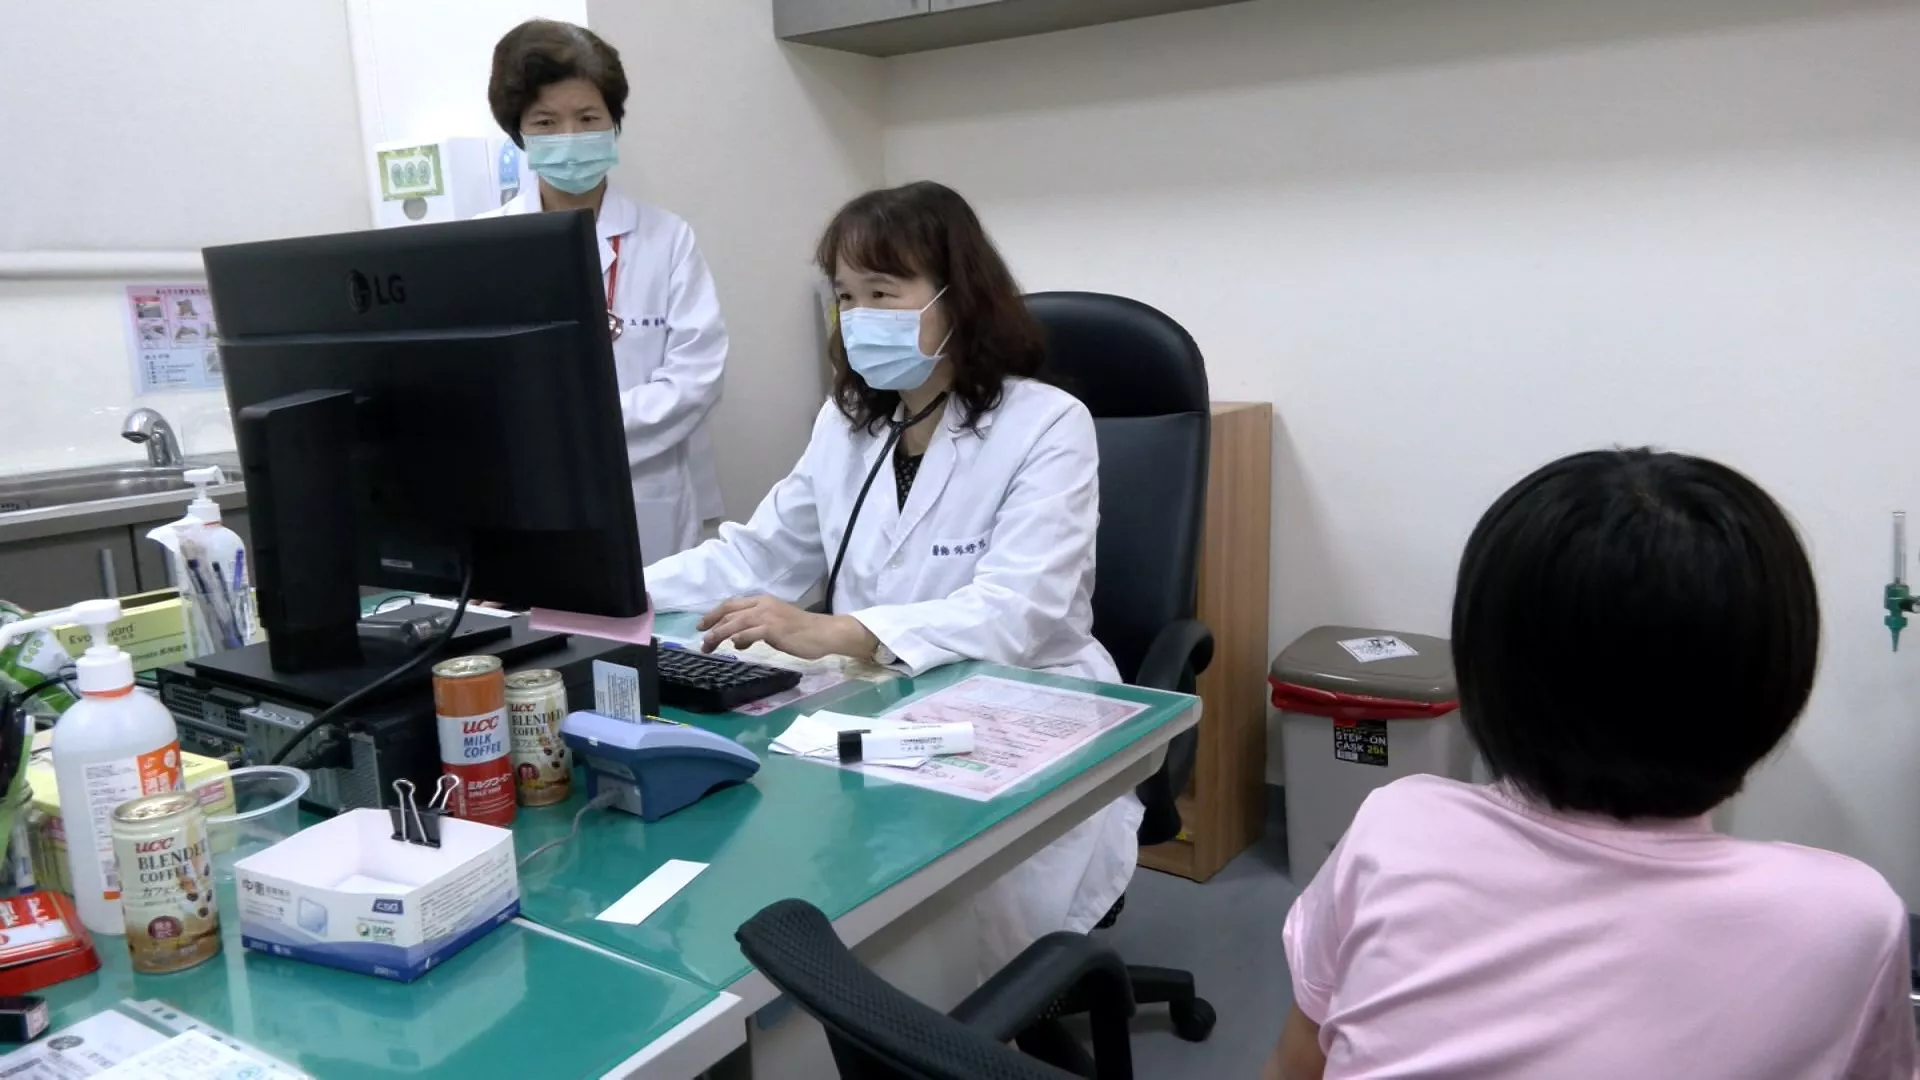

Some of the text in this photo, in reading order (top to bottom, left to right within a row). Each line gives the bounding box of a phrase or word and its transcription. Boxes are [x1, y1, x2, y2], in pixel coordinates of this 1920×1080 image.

[374, 274, 407, 305] LG
[69, 622, 134, 645] Evouard
[463, 715, 499, 734] UCC
[463, 733, 492, 748] MILK
[464, 740, 501, 758] COFFEE
[136, 836, 174, 853] UCC
